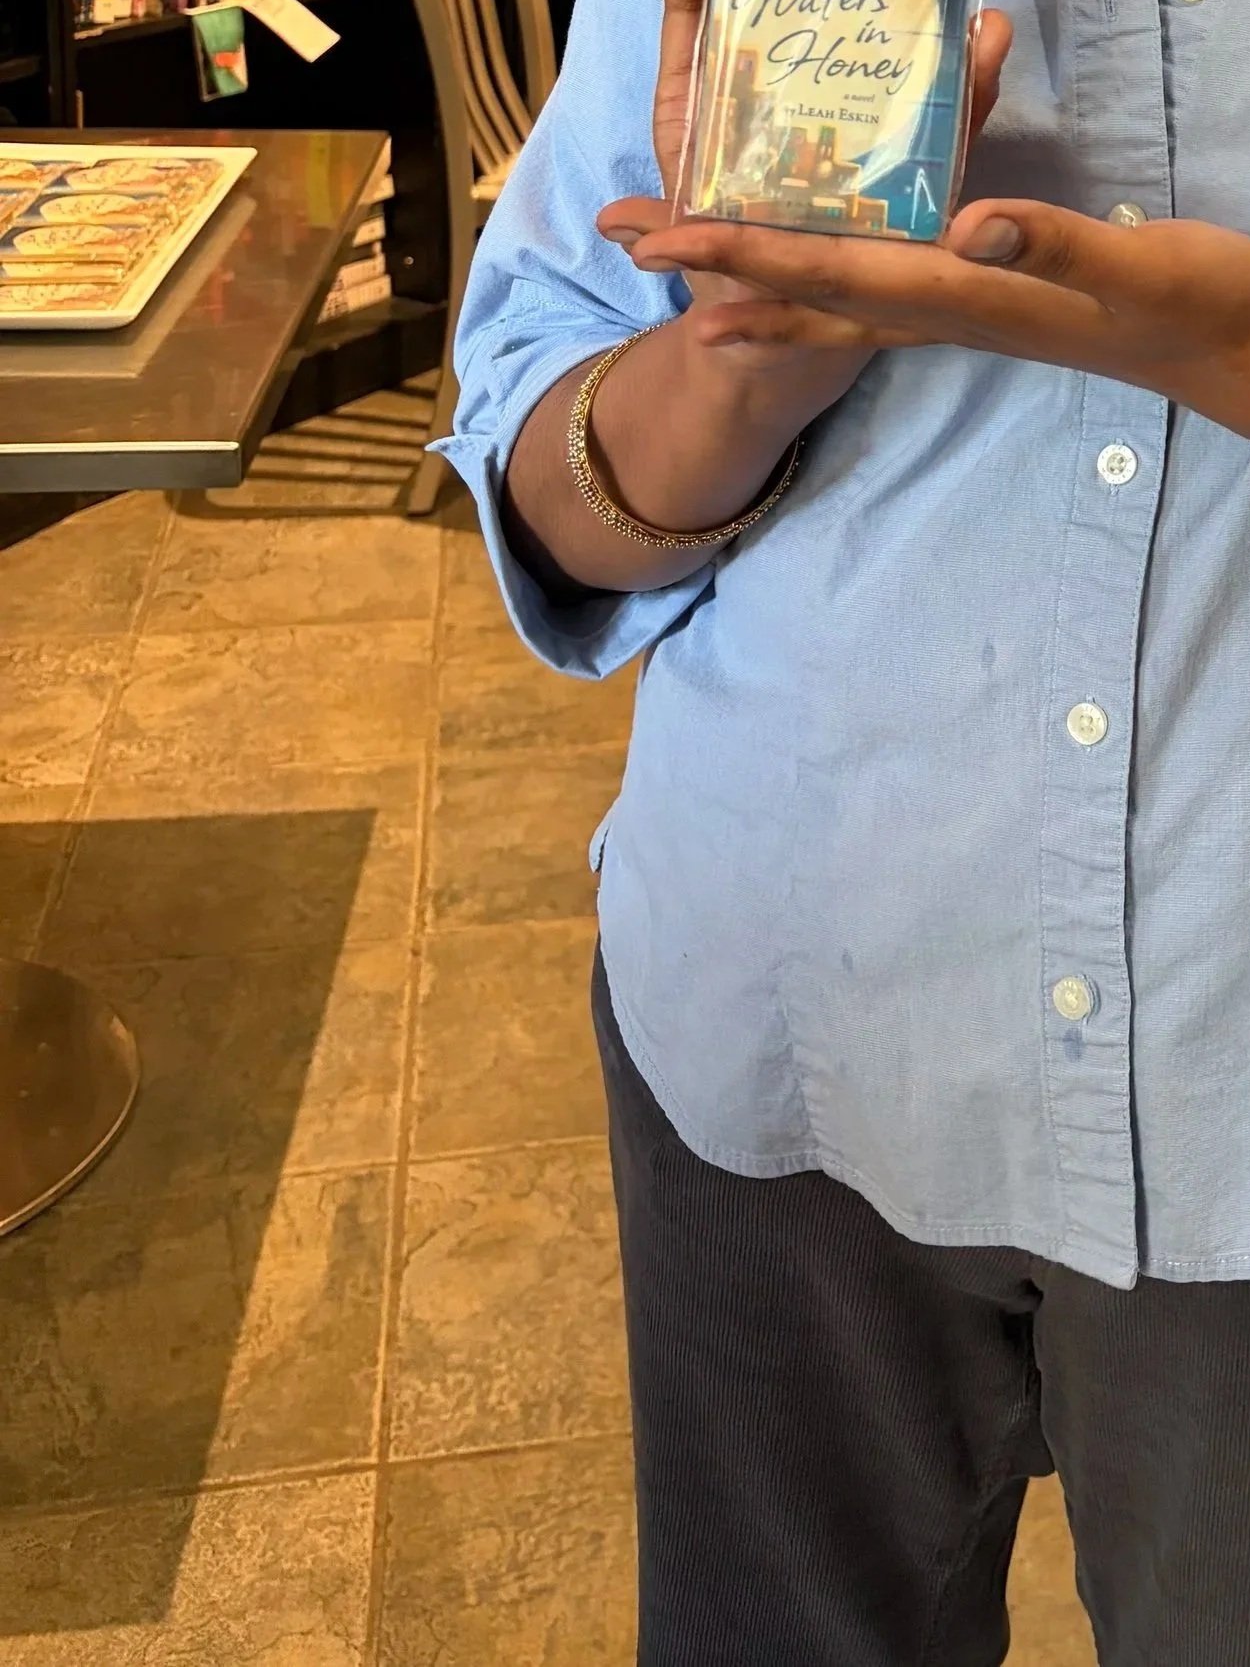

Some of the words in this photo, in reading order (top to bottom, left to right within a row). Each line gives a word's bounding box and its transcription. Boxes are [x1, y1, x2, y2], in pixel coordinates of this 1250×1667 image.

[856, 19, 892, 45] in
[766, 28, 915, 96] Honey
[851, 93, 876, 104] novel
